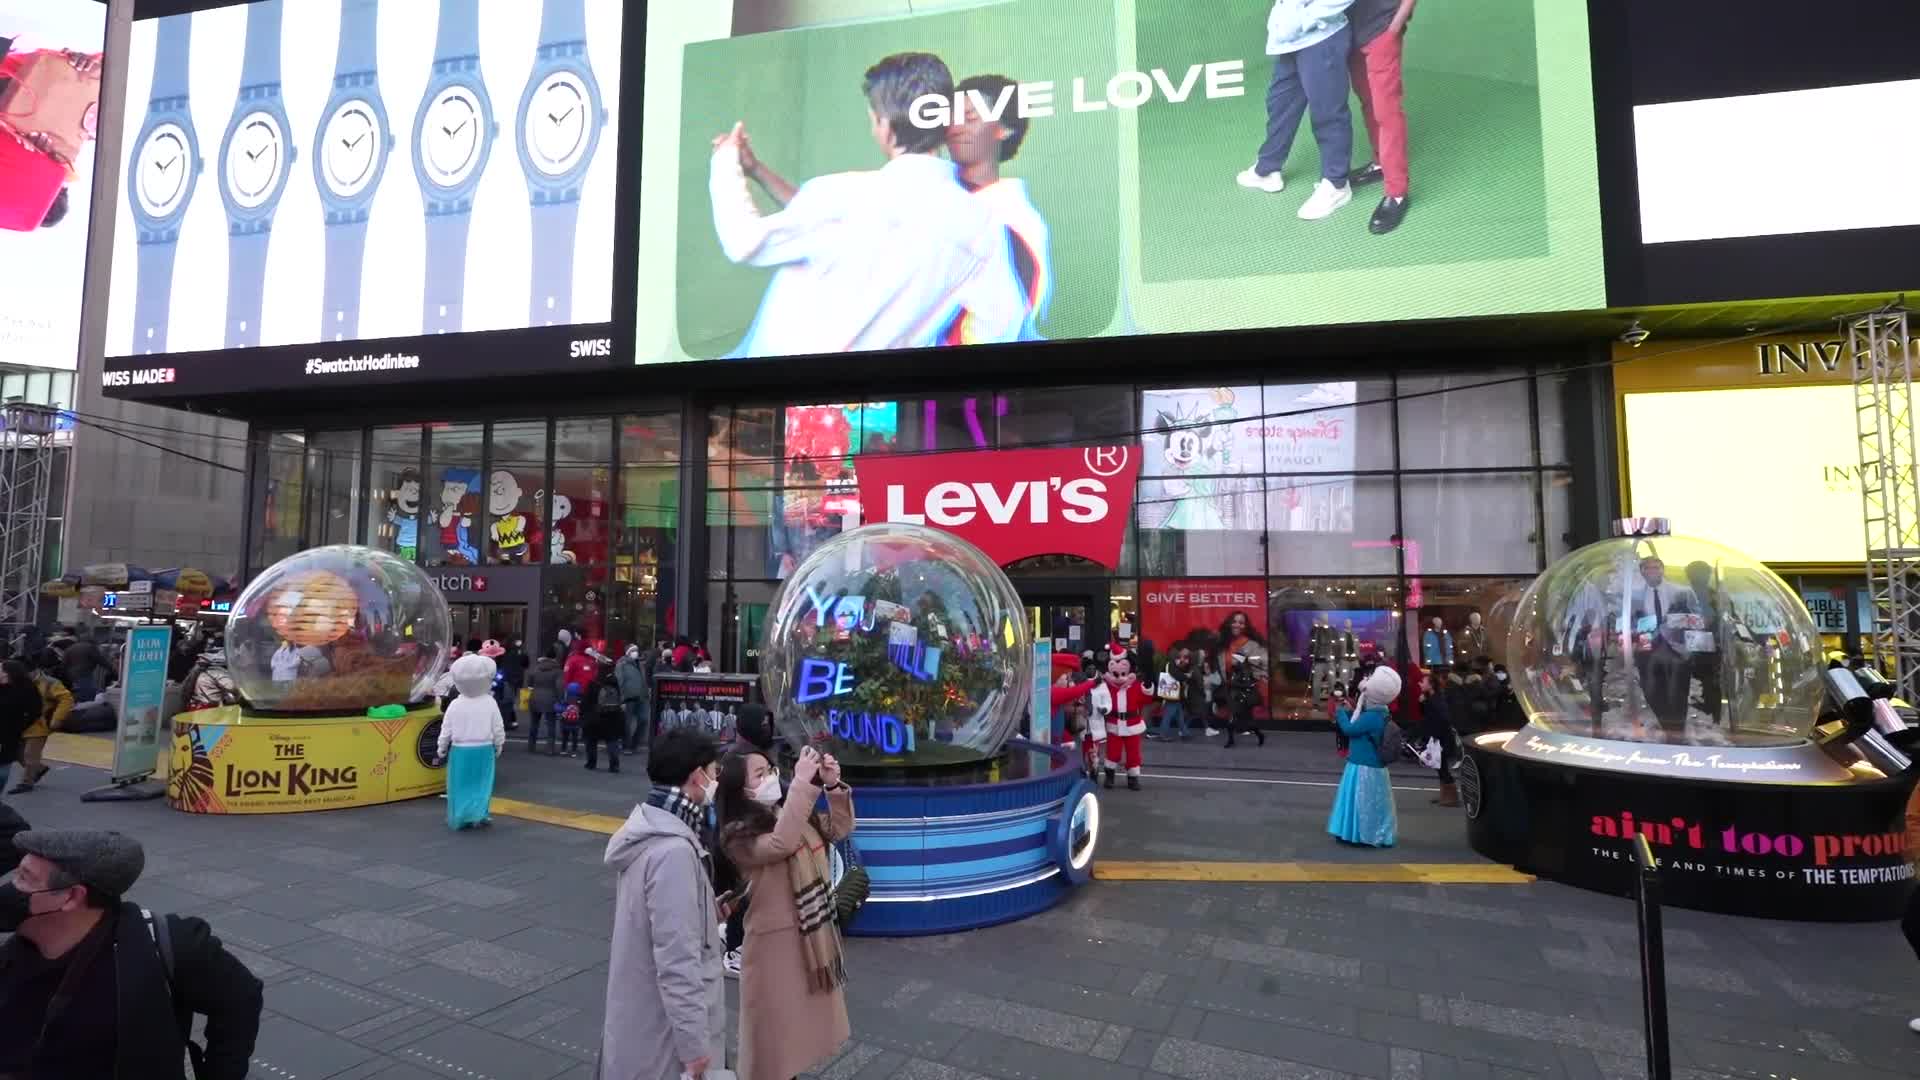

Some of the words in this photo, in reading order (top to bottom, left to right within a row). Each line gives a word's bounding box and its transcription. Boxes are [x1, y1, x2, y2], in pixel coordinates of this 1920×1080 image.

[908, 80, 1054, 130] GIVE
[1072, 59, 1245, 113] LOVE
[132, 367, 166, 384] MADE
[305, 352, 420, 374] #SwatchxHodinkee
[806, 586, 876, 631] YOU
[1146, 592, 1185, 603] GIVE
[1189, 591, 1257, 604] BETTER
[746, 649, 760, 657] GIV
[797, 658, 855, 704] BE
[829, 708, 905, 754] FOUND
[274, 744, 304, 757] THE
[225, 763, 281, 797] LION
[288, 763, 357, 796] KING
[1591, 811, 1705, 849] ain't
[1720, 824, 1804, 857] too
[1813, 832, 1907, 866] prou
[1593, 848, 1620, 860] THE
[1629, 855, 1663, 866] LE
[1672, 861, 1706, 873] AND
[1716, 865, 1766, 878] TIMES
[1776, 870, 1796, 880] OF
[1802, 868, 1836, 885] THE
